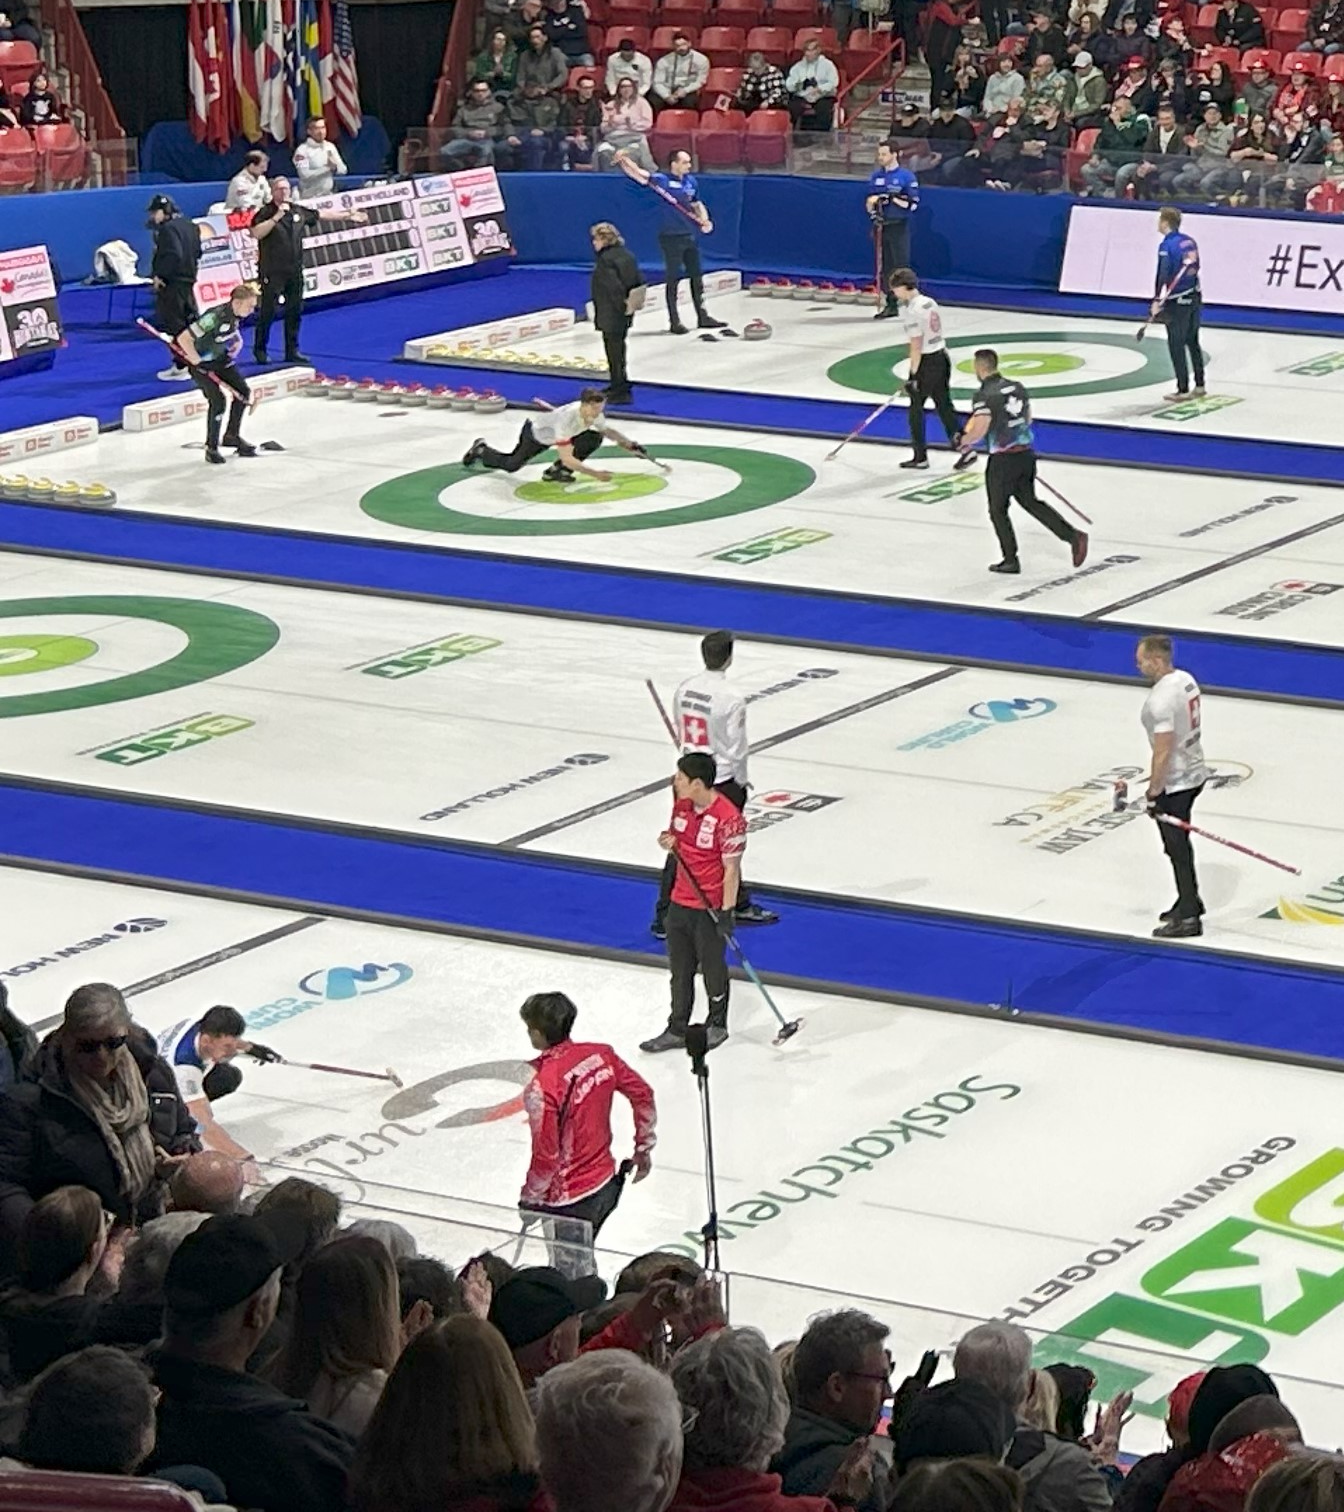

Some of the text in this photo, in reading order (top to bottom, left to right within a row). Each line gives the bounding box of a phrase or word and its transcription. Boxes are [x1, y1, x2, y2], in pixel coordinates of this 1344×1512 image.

[362, 635, 503, 679] BKT
[96, 713, 256, 766] BKT
[420, 764, 572, 822] NEW HOLLAND
[57, 932, 121, 959] NEW
[990, 1135, 1298, 1326] GROWING TOGETH
